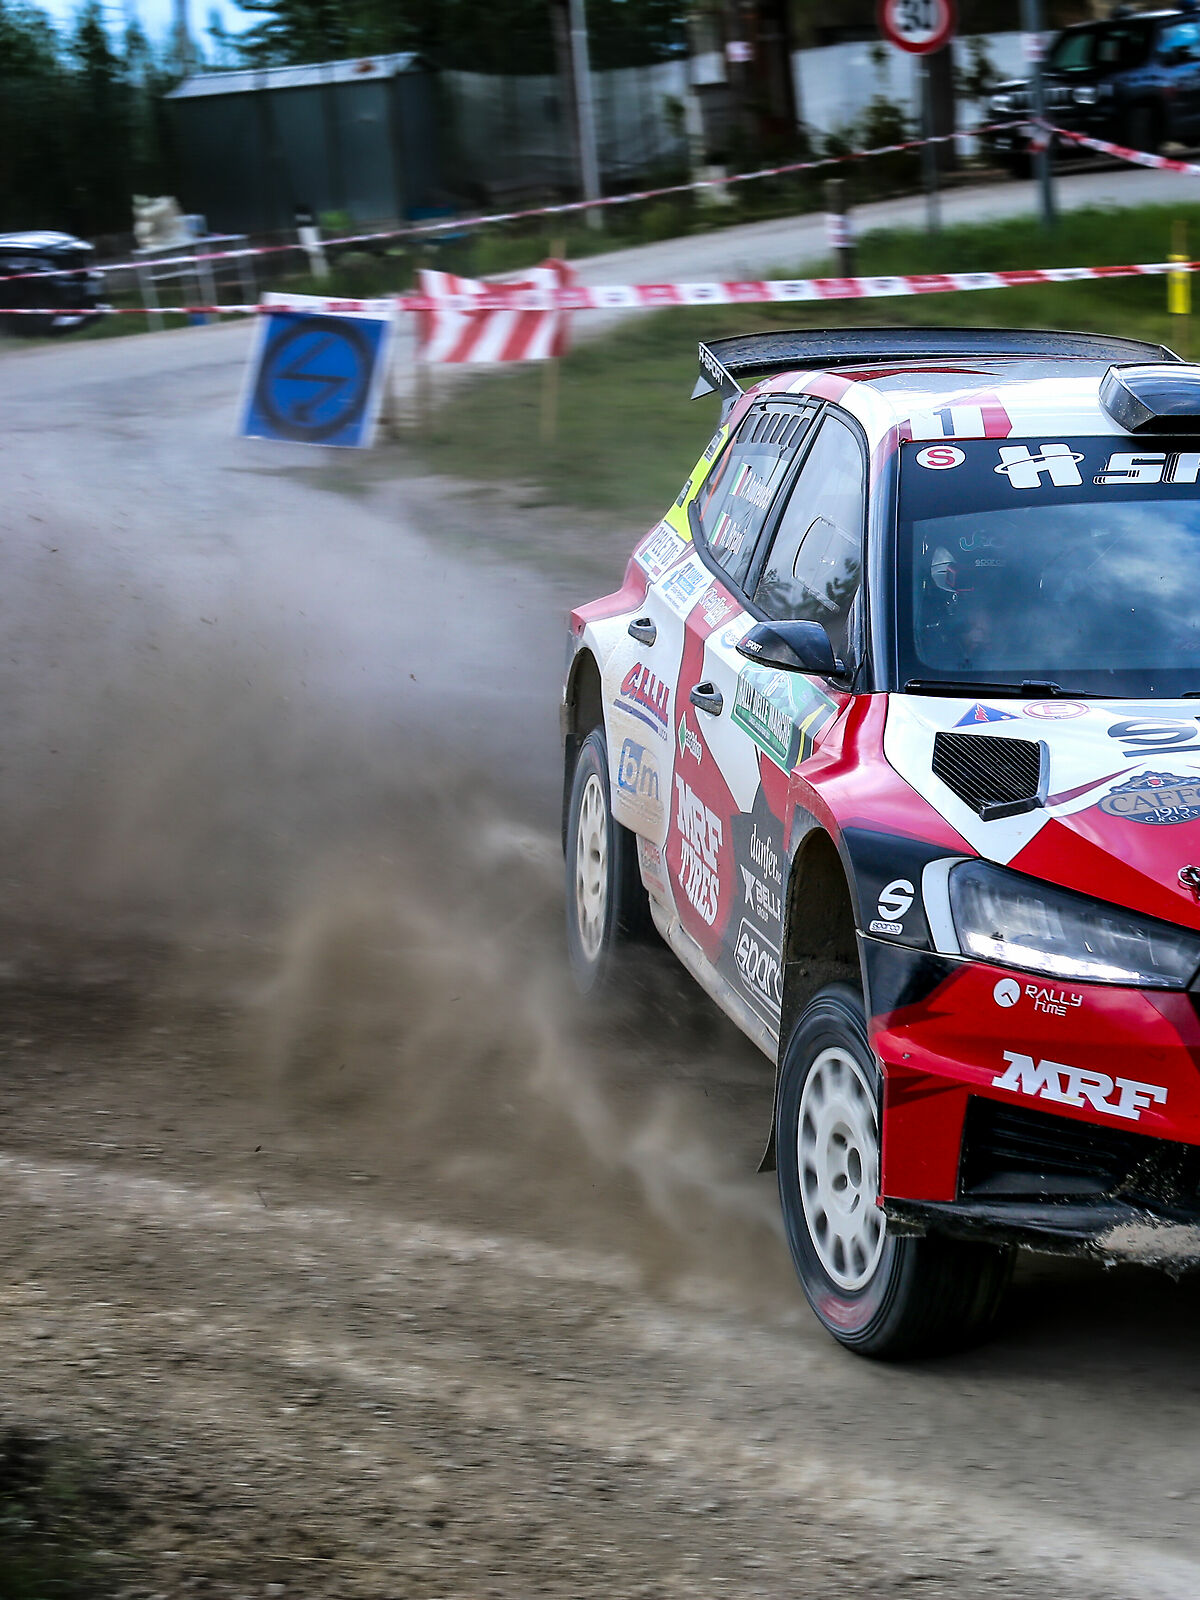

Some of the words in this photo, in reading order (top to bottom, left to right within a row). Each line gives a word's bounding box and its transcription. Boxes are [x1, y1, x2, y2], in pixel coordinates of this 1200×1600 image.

[933, 408, 955, 436] 1
[675, 773, 723, 873] MRF
[1145, 808, 1199, 823] GROUP
[1153, 804, 1191, 819] 1915
[678, 838, 721, 927] TYRES
[871, 921, 901, 933] sparco
[1025, 984, 1084, 1007] RALLY
[991, 1050, 1168, 1121] MRF
